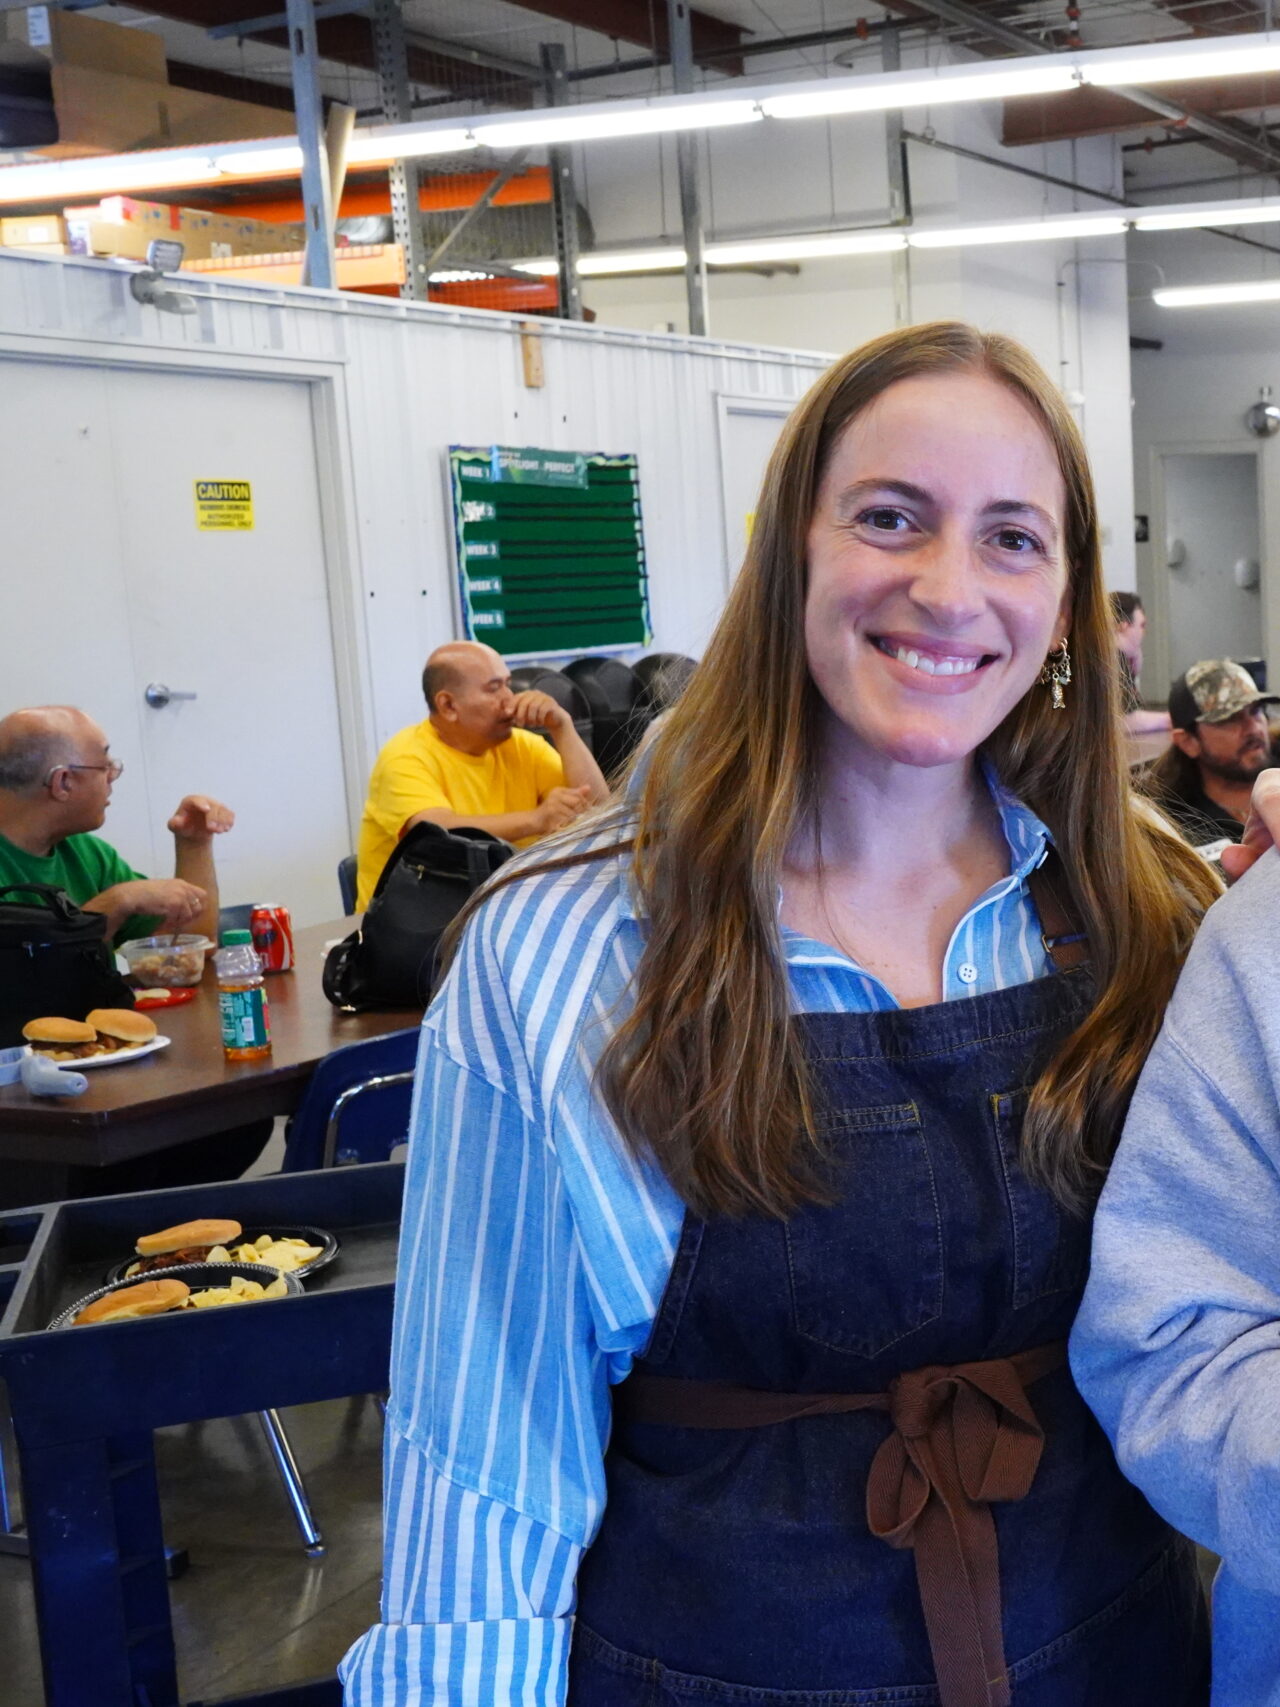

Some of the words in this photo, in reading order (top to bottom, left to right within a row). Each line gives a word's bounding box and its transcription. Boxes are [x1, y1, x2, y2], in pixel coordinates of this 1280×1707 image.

[461, 466, 483, 478] WEEK
[198, 484, 249, 499] CAUTION
[466, 544, 489, 556] WEEK
[468, 580, 491, 592] WEEK
[471, 613, 494, 625] WEEK
